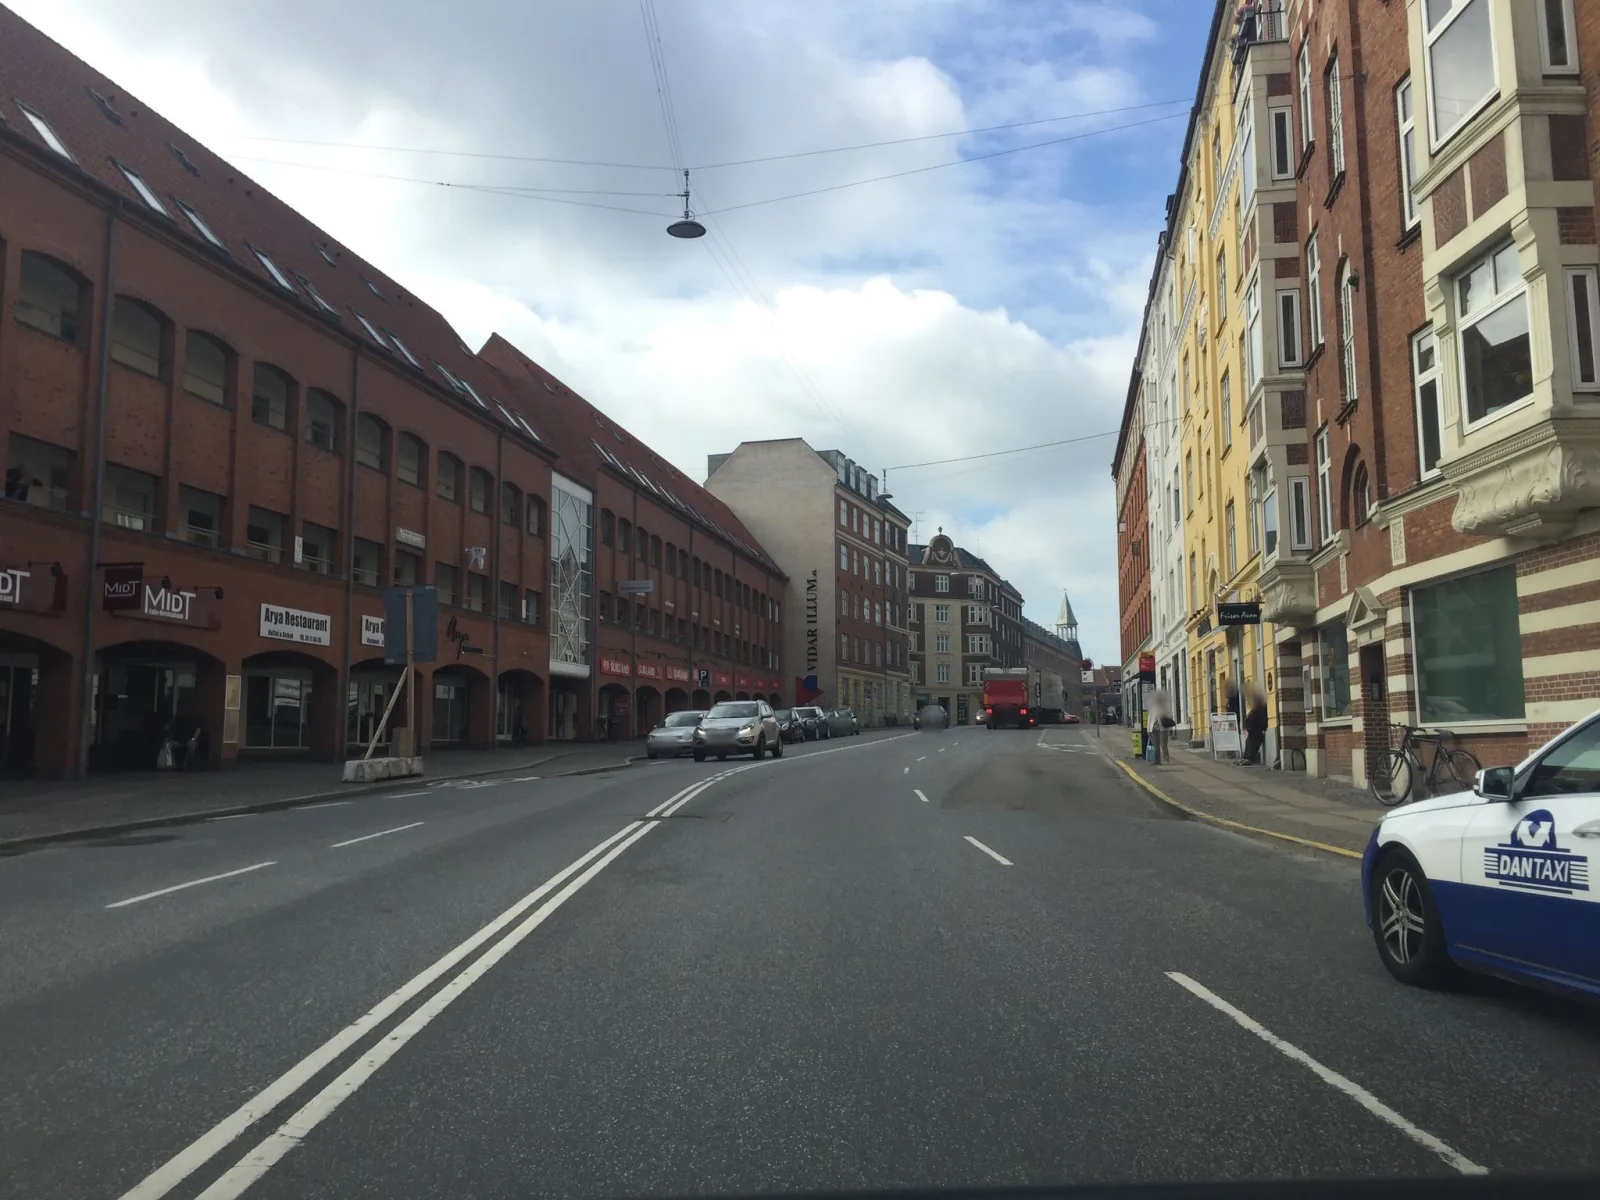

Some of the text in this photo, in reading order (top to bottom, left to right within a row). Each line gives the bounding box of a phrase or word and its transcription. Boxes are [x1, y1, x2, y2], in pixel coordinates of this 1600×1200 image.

[0, 568, 31, 604] DT
[105, 580, 140, 597] MIDT
[144, 584, 197, 620] MIDT
[806, 579, 818, 624] ILLUM
[264, 607, 328, 632] Arya Restaurant
[365, 618, 380, 634] Arya
[806, 629, 818, 672] VIDAR
[700, 670, 707, 679] P
[1499, 854, 1570, 883] DANTAXI
